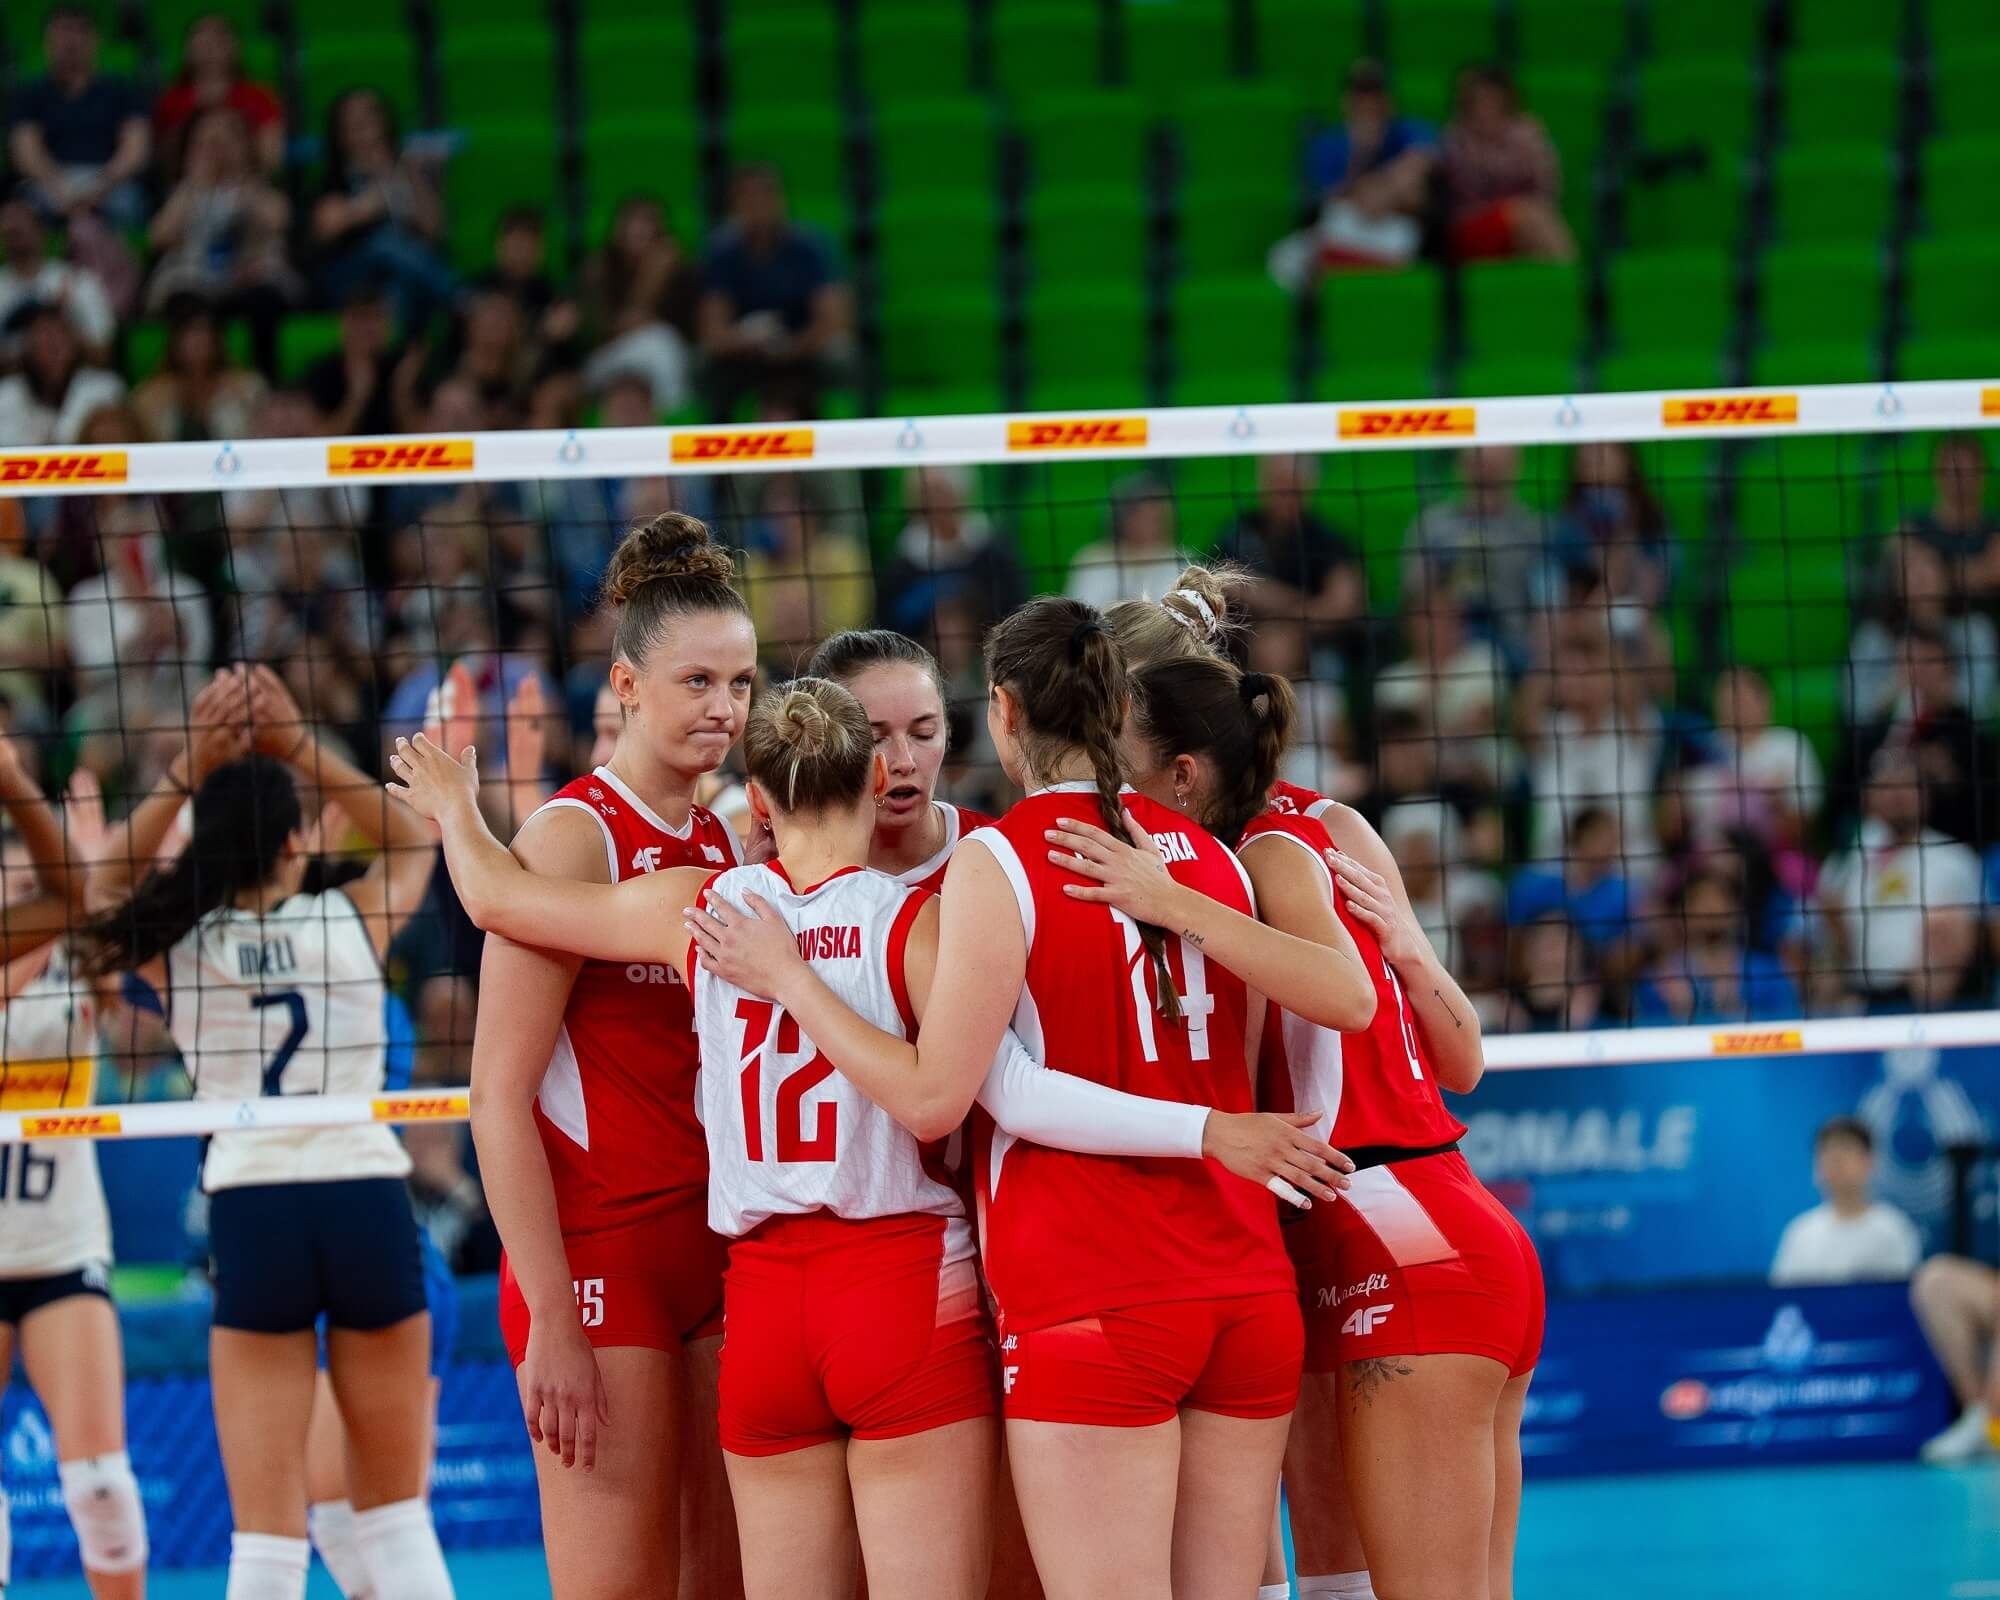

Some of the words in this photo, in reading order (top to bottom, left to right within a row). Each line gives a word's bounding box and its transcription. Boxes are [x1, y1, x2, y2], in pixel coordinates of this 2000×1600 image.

[1682, 400, 1778, 421] DHL
[1028, 422, 1126, 445] DHL
[1357, 412, 1453, 434] DHL
[351, 446, 452, 468] DHL
[693, 434, 792, 457] DHL
[2, 458, 105, 481] DHL
[1149, 832, 1198, 864] SKA
[632, 847, 662, 873] 4F
[625, 963, 687, 985] ORL
[735, 998, 838, 1162] 12
[1341, 1304, 1394, 1336] 4F
